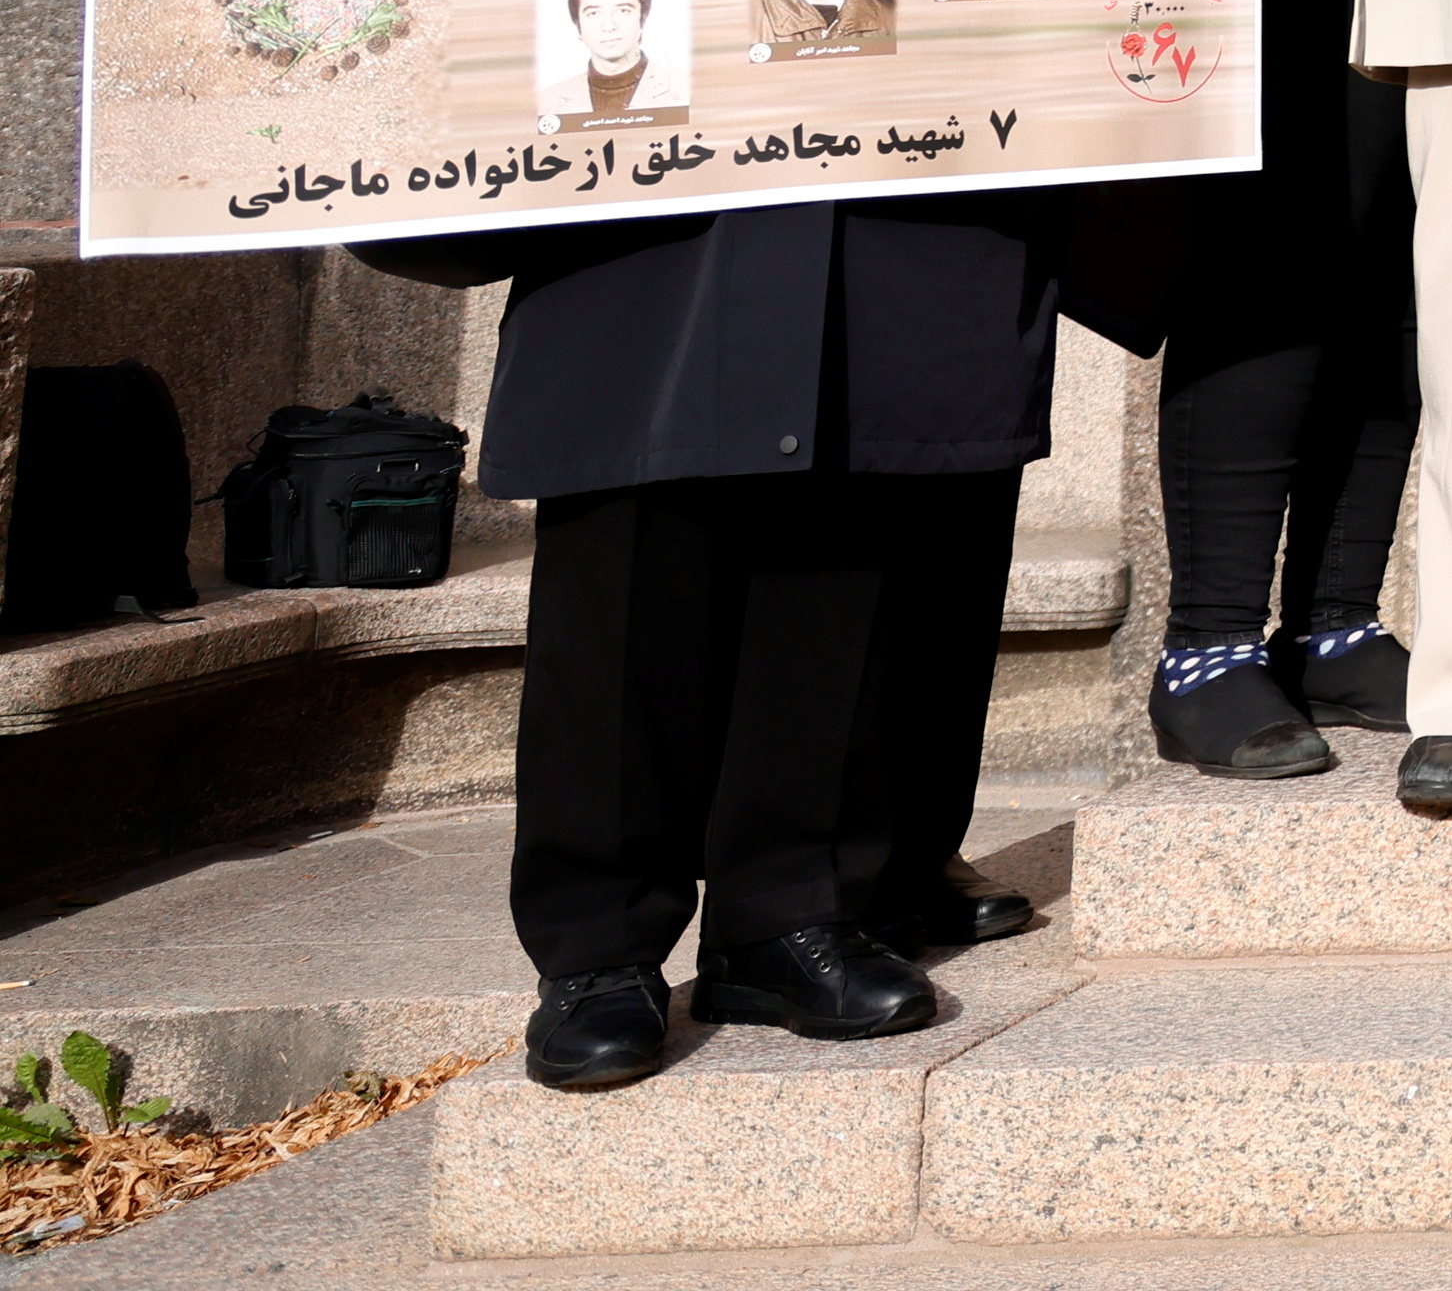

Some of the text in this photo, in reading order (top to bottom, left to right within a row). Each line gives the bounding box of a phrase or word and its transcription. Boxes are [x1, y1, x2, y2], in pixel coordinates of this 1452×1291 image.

[228, 108, 1018, 218] ۷ شهید مجاهد خلق از خانواده ماجانی
